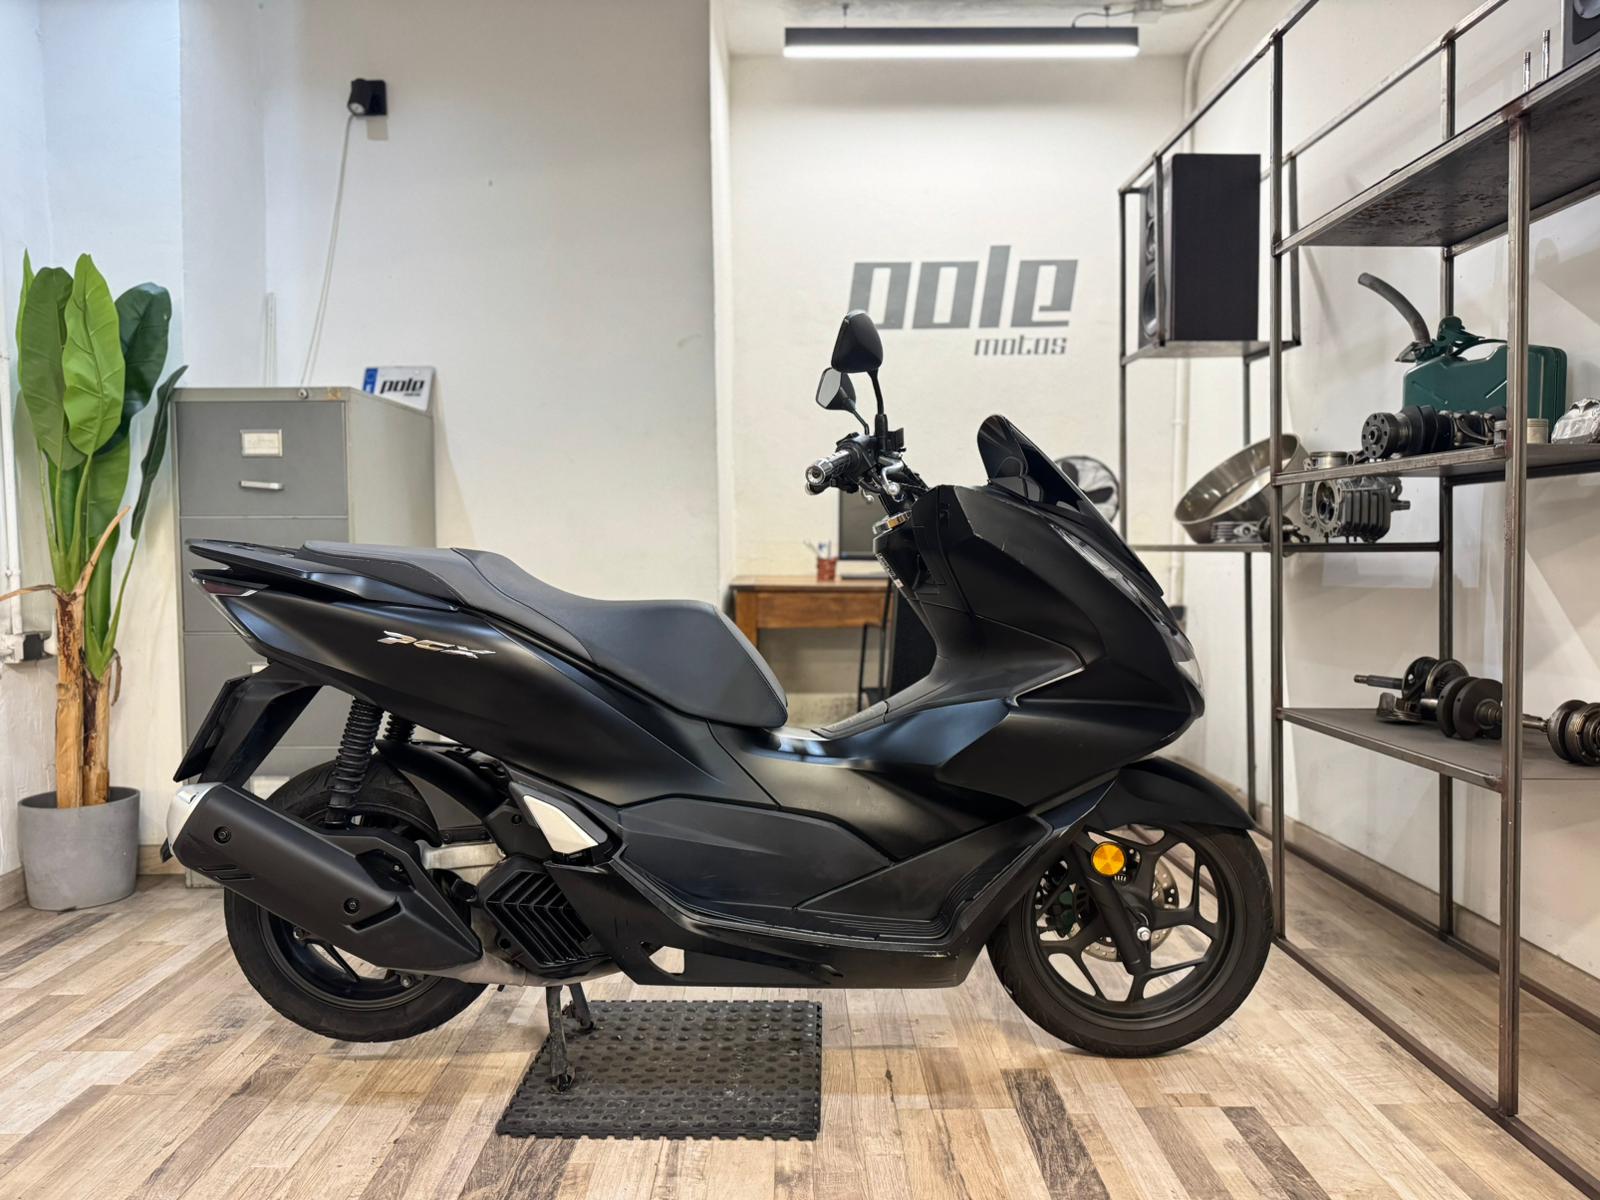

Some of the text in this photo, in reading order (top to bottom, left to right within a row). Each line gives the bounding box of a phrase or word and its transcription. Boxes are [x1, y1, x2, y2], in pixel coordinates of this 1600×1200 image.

[847, 245, 1078, 329] pole
[974, 335, 1067, 356] motos
[380, 378, 424, 394] pole
[377, 630, 496, 659] PCX
